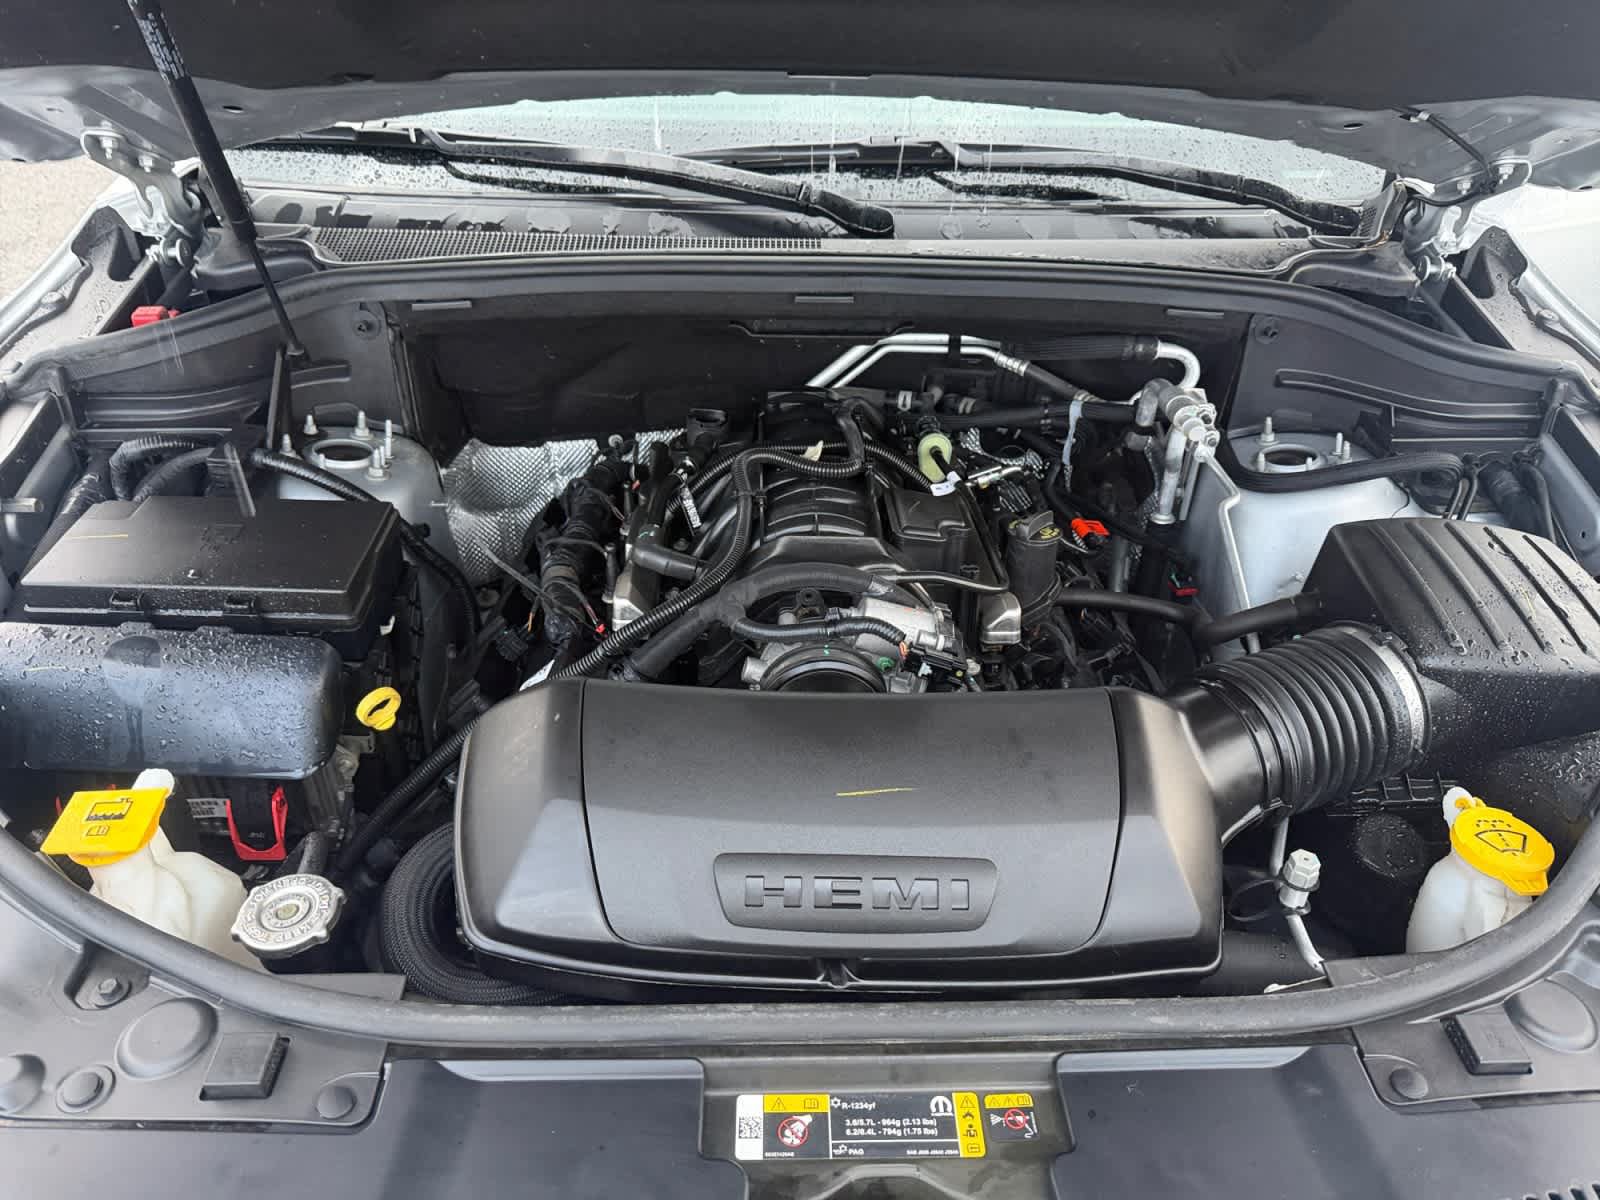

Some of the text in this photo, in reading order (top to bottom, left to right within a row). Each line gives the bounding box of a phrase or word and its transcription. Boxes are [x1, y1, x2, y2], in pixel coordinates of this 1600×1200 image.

[744, 875, 970, 911] HEMI
[841, 1102, 876, 1111] R-1234yf
[902, 1118, 921, 1127] (2.13
[922, 1118, 937, 1127] lbs)
[923, 1127, 938, 1137] lbs)
